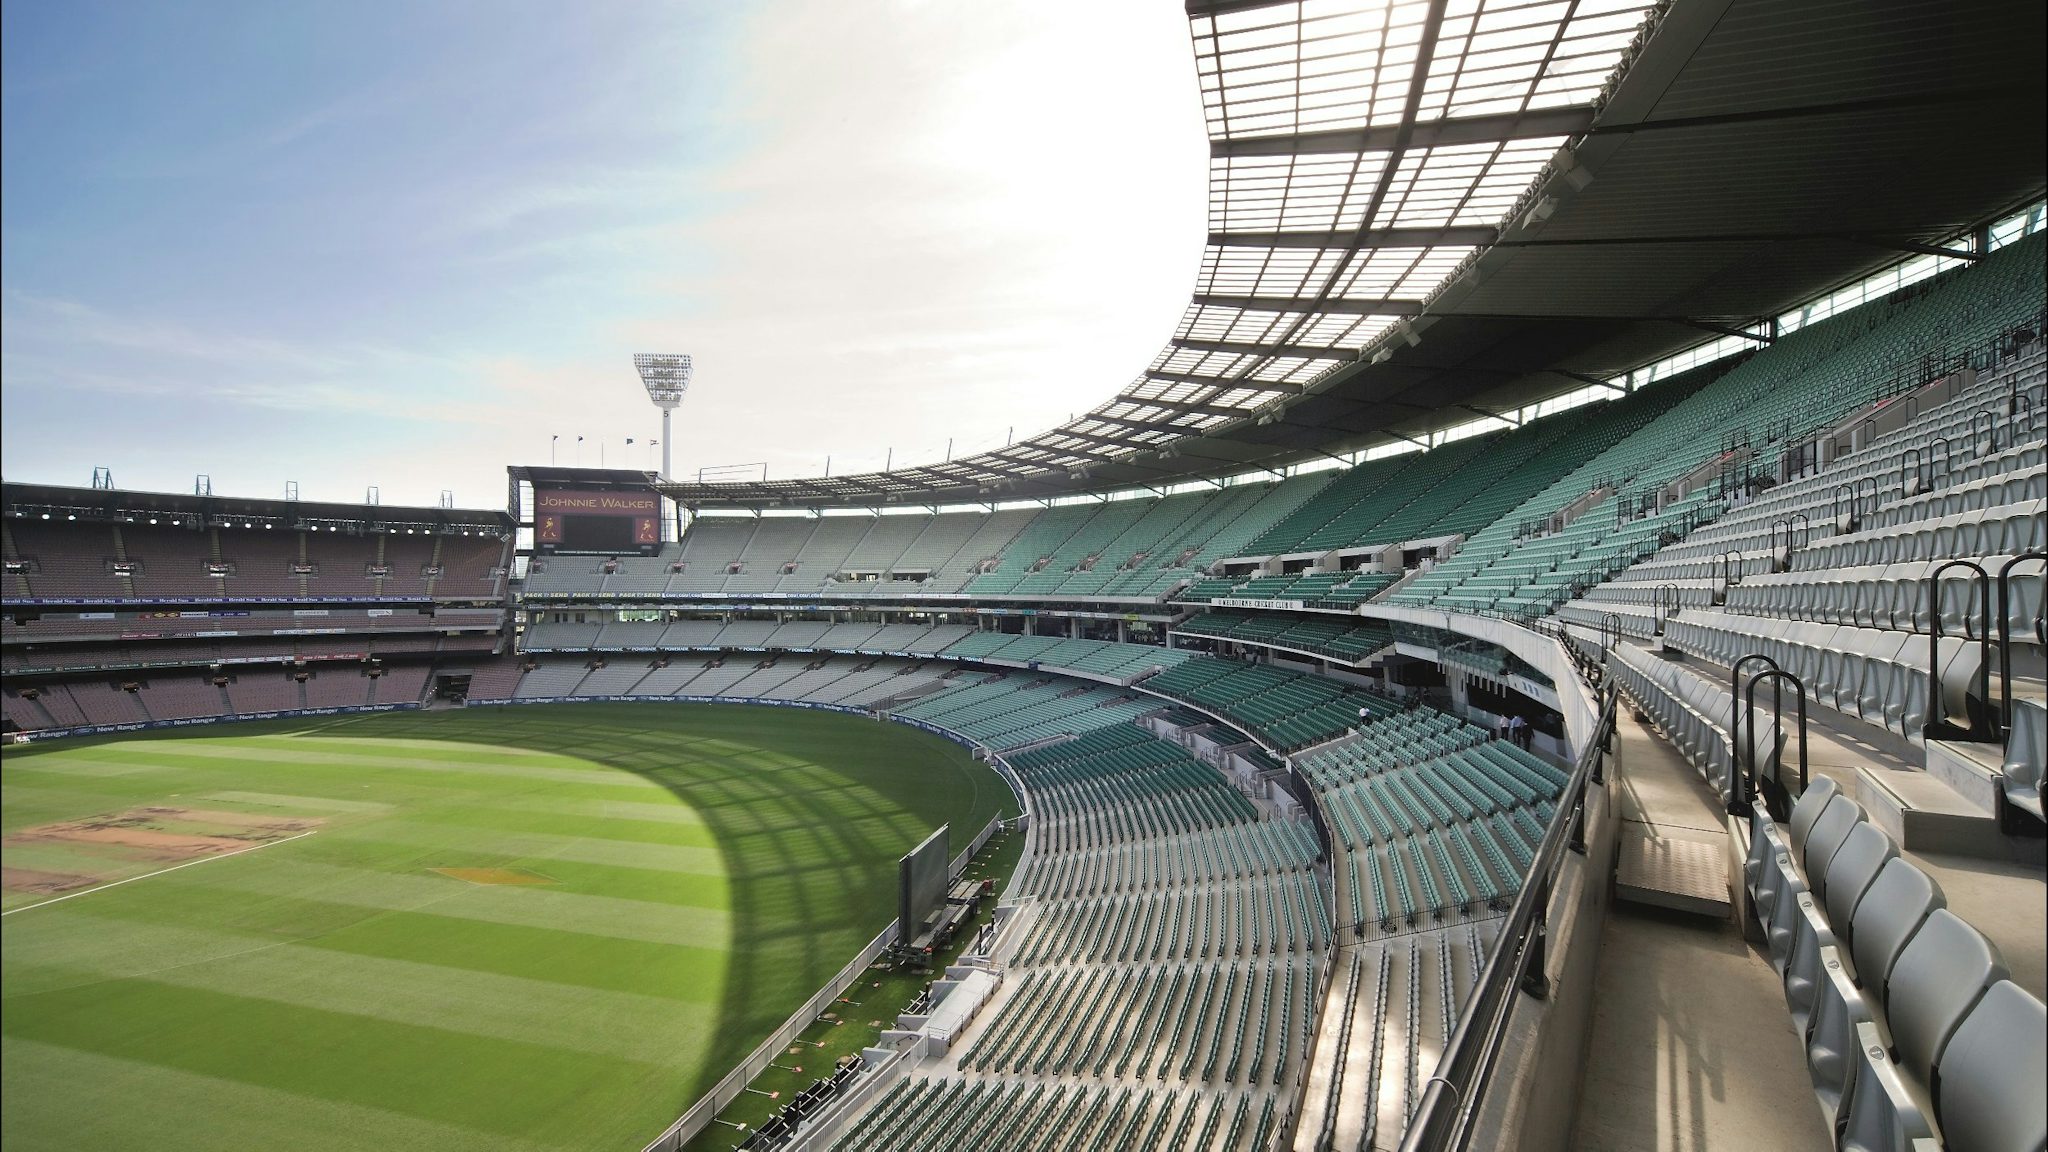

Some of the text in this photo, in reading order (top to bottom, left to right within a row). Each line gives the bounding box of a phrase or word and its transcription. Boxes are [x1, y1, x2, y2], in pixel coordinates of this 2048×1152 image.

[663, 410, 669, 418] 5
[540, 496, 654, 509] JOHNNIE WALKER
[191, 717, 216, 725] Ranger
[117, 723, 146, 731] Ranger
